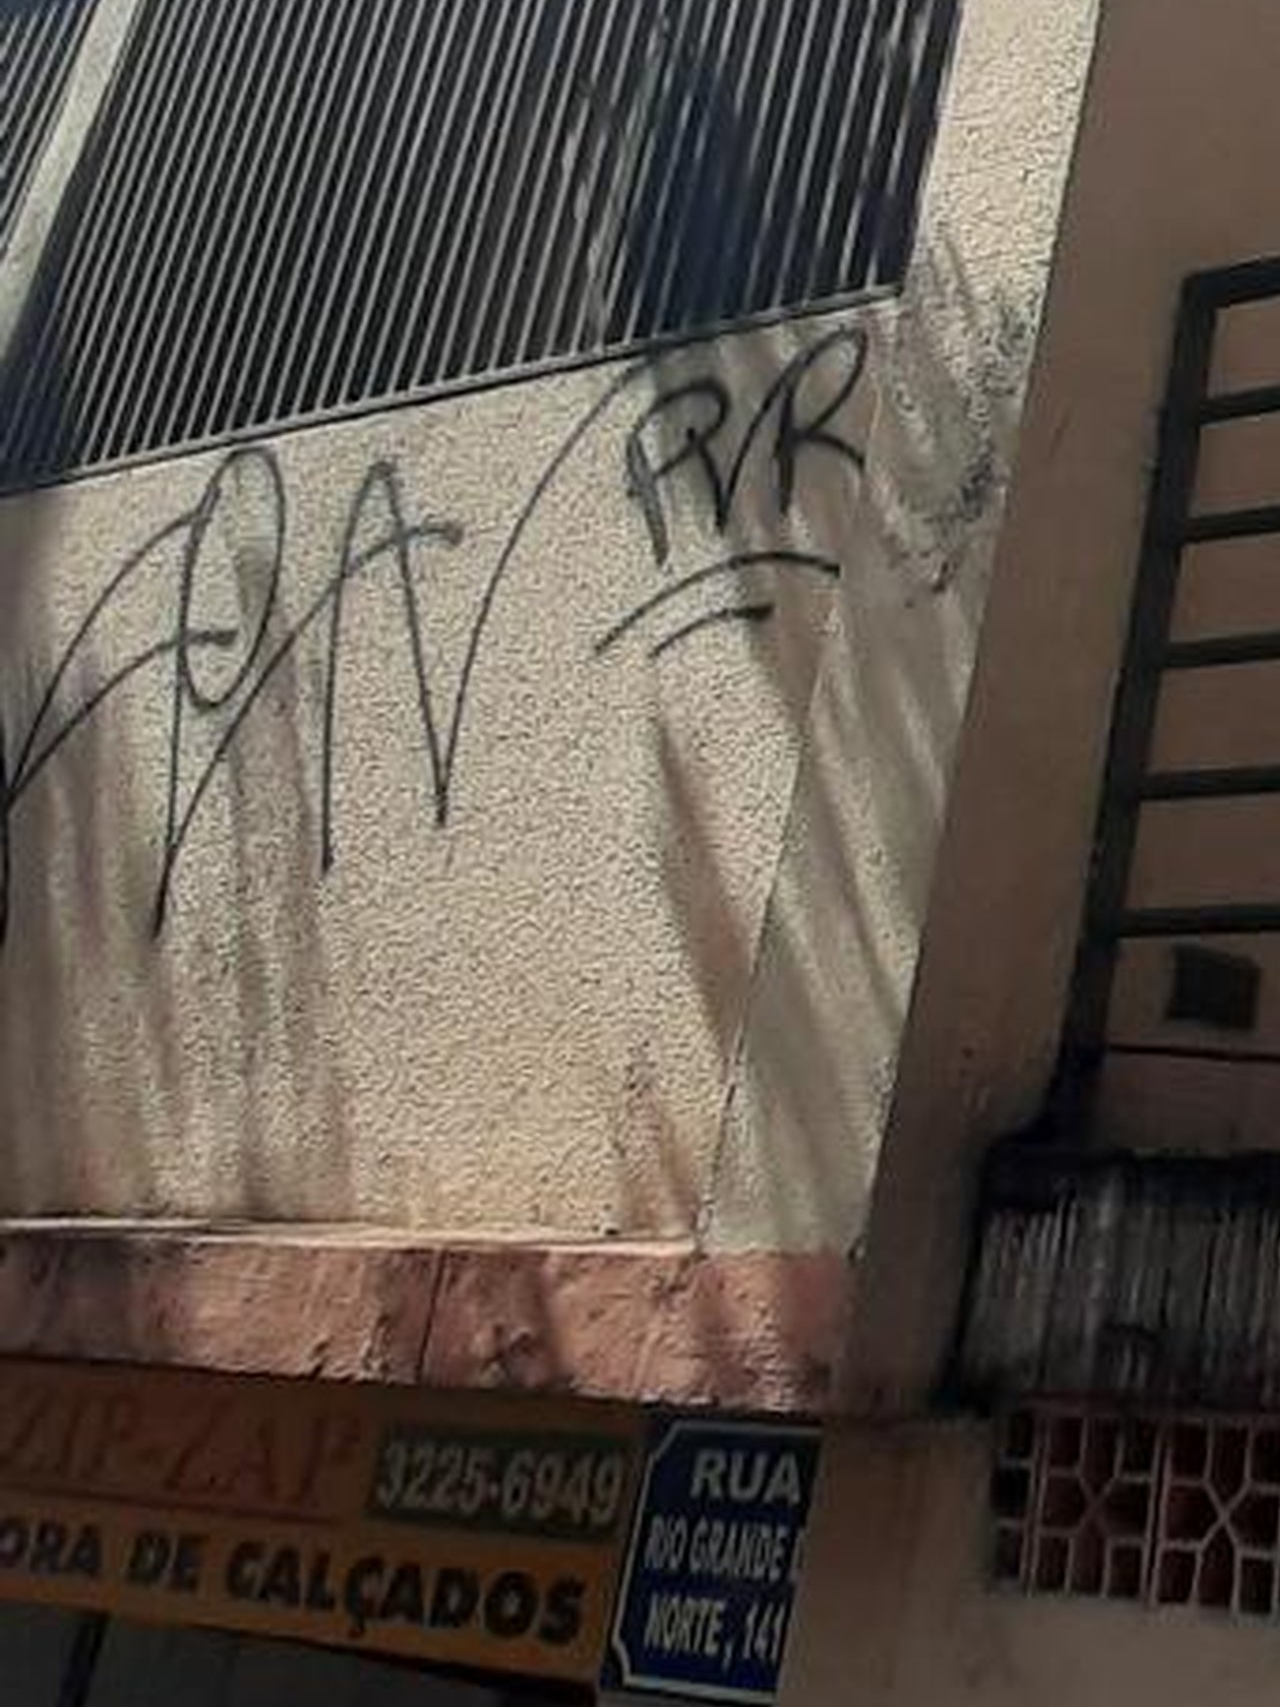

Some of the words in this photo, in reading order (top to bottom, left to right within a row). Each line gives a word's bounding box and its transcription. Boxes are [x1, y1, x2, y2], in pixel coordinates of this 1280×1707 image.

[375, 1436, 624, 1528] 3225-6949
[690, 1448, 801, 1505] RUA
[128, 1529, 209, 1591] DE
[226, 1538, 588, 1646] CALÇADOS
[644, 1514, 688, 1572] RIO
[689, 1517, 790, 1583] GRANDE
